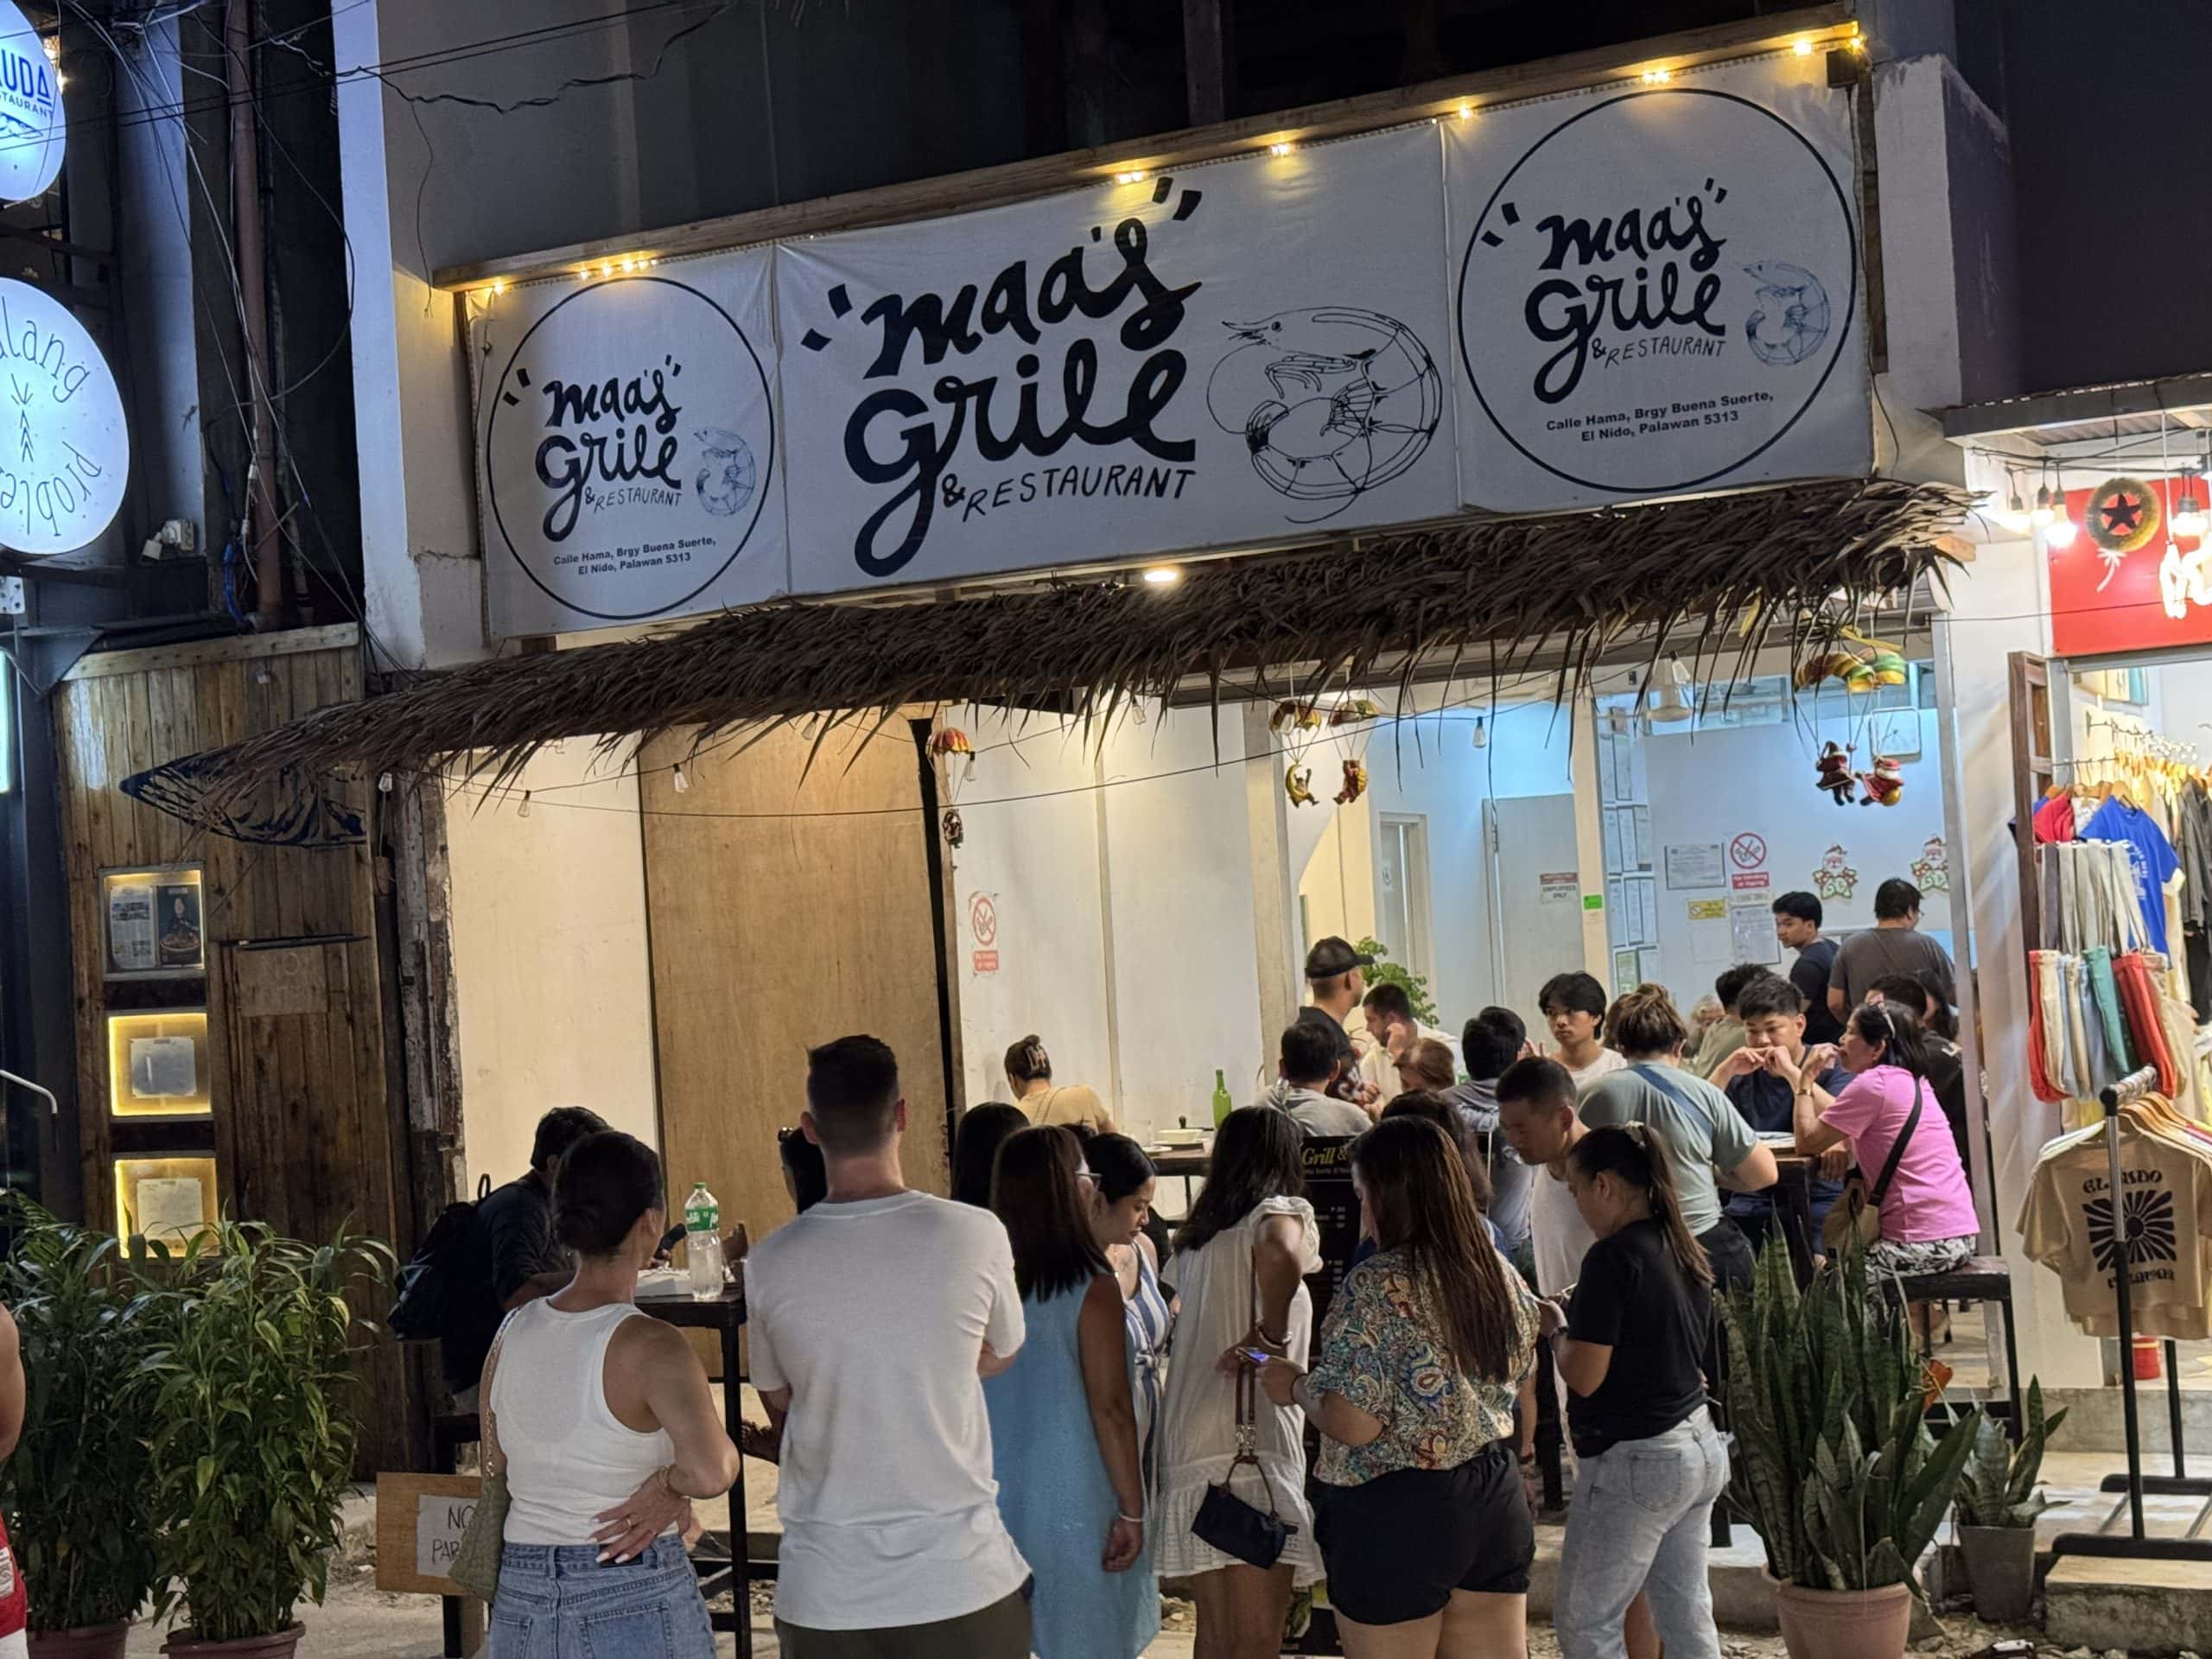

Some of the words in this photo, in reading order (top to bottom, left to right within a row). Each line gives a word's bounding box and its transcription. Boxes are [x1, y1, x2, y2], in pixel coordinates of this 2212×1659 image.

[0, 48, 52, 106] UDA
[0, 91, 53, 118] TAURANT
[0, 296, 91, 404] lang
[1592, 337, 1606, 359] &
[1605, 335, 1726, 370] RESTAURANT
[1546, 418, 1582, 431] Calle
[1586, 412, 1630, 427] Hama,
[1635, 406, 1668, 419] Brgy
[1672, 399, 1717, 414] Buena
[1720, 391, 1774, 407] Suerte,
[1581, 430, 1595, 442] El
[1599, 427, 1636, 439] Nido,
[1639, 418, 1700, 434] Palawan
[1704, 410, 1739, 426] 5313
[0, 440, 102, 537] proble
[584, 486, 595, 505] &
[593, 486, 683, 515] RESTAURANT
[942, 474, 966, 508] &
[961, 464, 1198, 523] RESTAURANT
[553, 555, 580, 566] Calle
[582, 550, 614, 563] Hama,
[616, 546, 640, 558] Brgy
[643, 542, 676, 554] Buena
[677, 536, 716, 548] Suerte,
[578, 566, 588, 575] El
[591, 563, 617, 574] Nido,
[620, 557, 663, 571] Palawan
[665, 551, 691, 563] 5313
[1301, 1147, 1336, 1166] Grill
[432, 1538, 461, 1564] PAR
